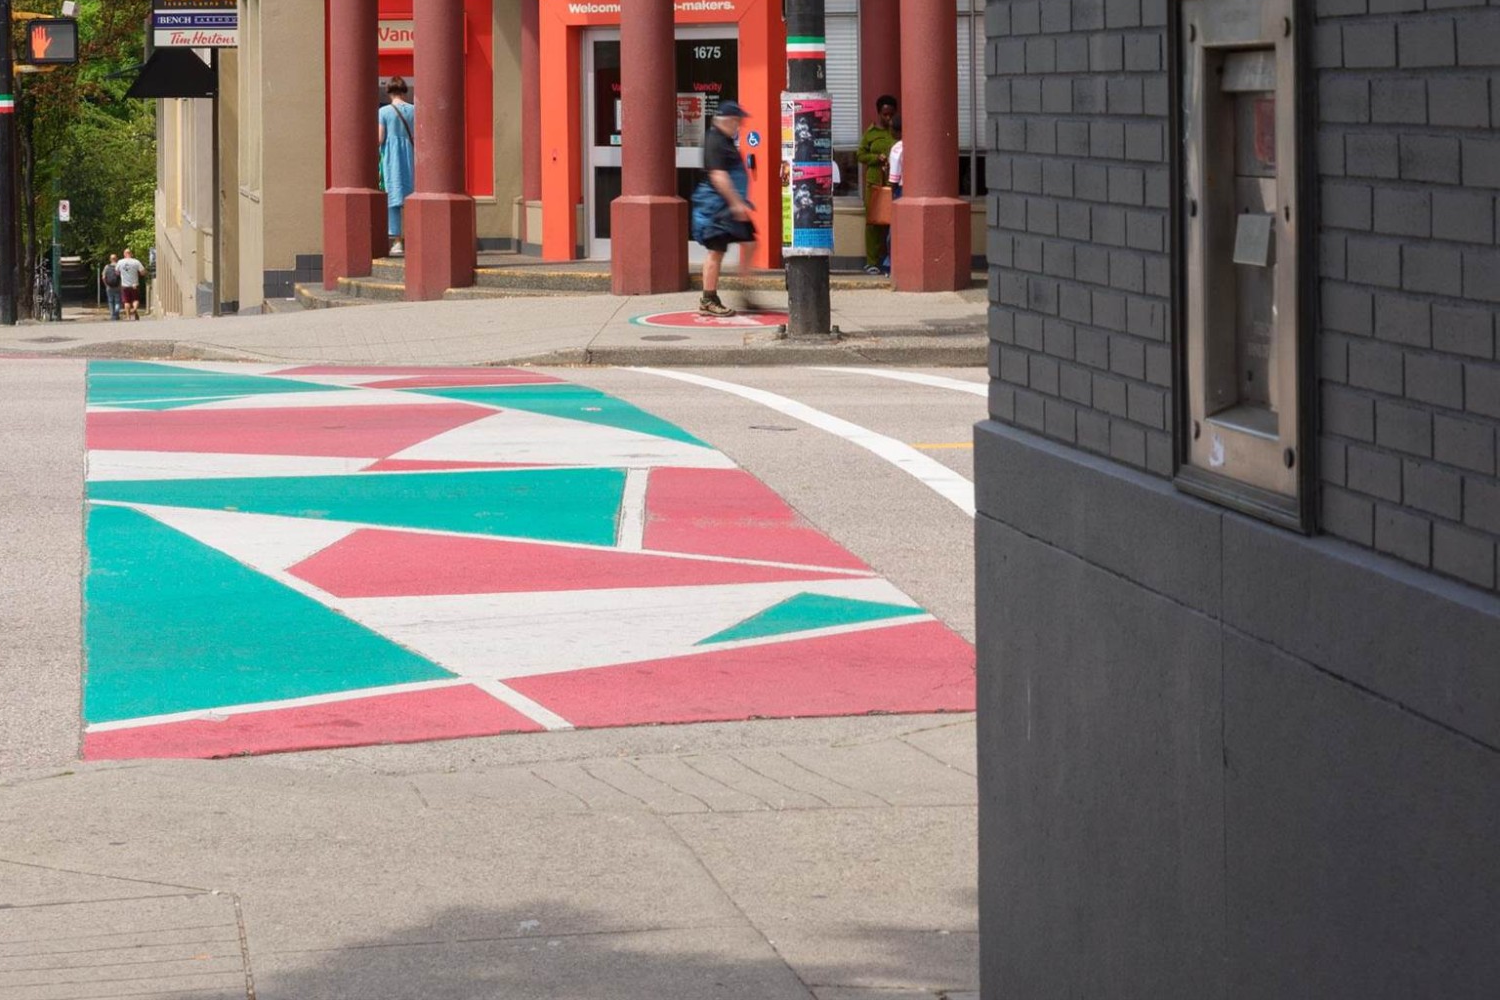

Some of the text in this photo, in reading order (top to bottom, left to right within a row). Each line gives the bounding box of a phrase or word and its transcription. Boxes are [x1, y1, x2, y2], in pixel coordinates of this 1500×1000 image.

[160, 16, 192, 24] BENCH
[170, 31, 235, 44] Tim Hortons
[378, 27, 414, 42] Van
[693, 46, 721, 59] 1675
[693, 83, 722, 93] Vancity
